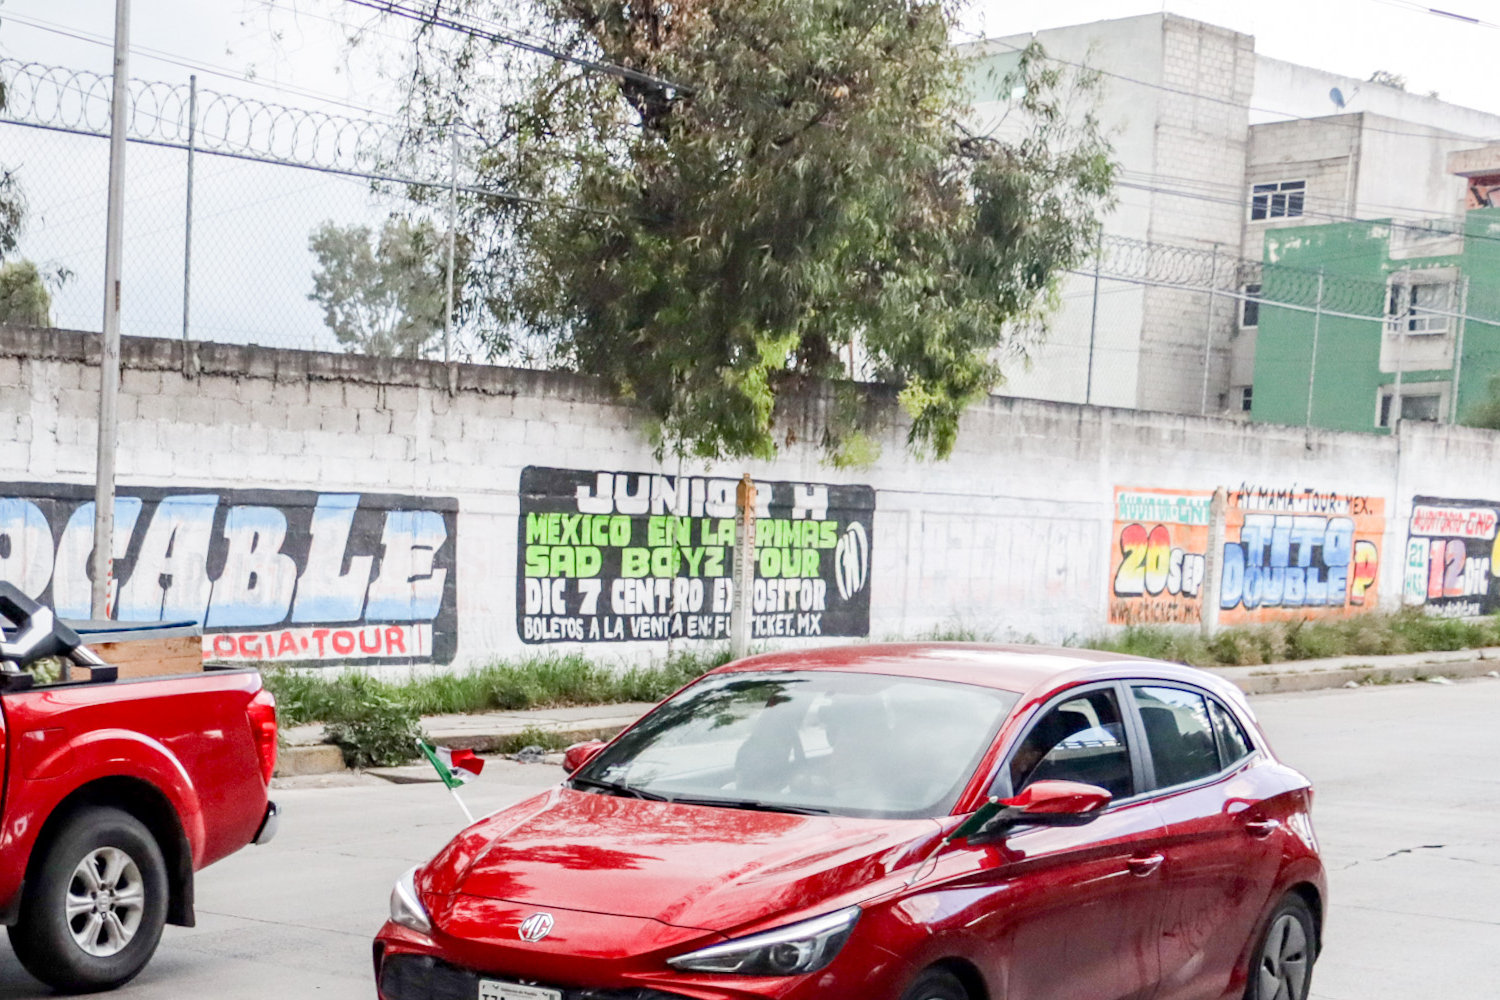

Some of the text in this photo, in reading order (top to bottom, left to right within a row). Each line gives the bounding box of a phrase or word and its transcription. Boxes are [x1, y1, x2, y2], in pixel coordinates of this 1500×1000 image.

[792, 483, 828, 520] H
[526, 511, 838, 548] MEXICO EN LARIMAS
[1241, 513, 1355, 568] TITO
[525, 545, 603, 578] SAD
[621, 547, 724, 578] BOYZ
[1114, 523, 1170, 598] 20
[1409, 543, 1423, 568] 21
[1428, 539, 1466, 599] 12
[1220, 542, 1348, 611] DOUBLE
[1350, 540, 1378, 606] P
[525, 578, 567, 615] DIC
[578, 578, 601, 615] 7
[611, 577, 704, 615] CENTRO
[312, 625, 407, 658] TOUR
[524, 616, 584, 641] BOLETOS
[589, 616, 600, 640] A
[604, 616, 624, 640] LA
[630, 613, 683, 639] VENTA
[521, 913, 552, 940] MG
